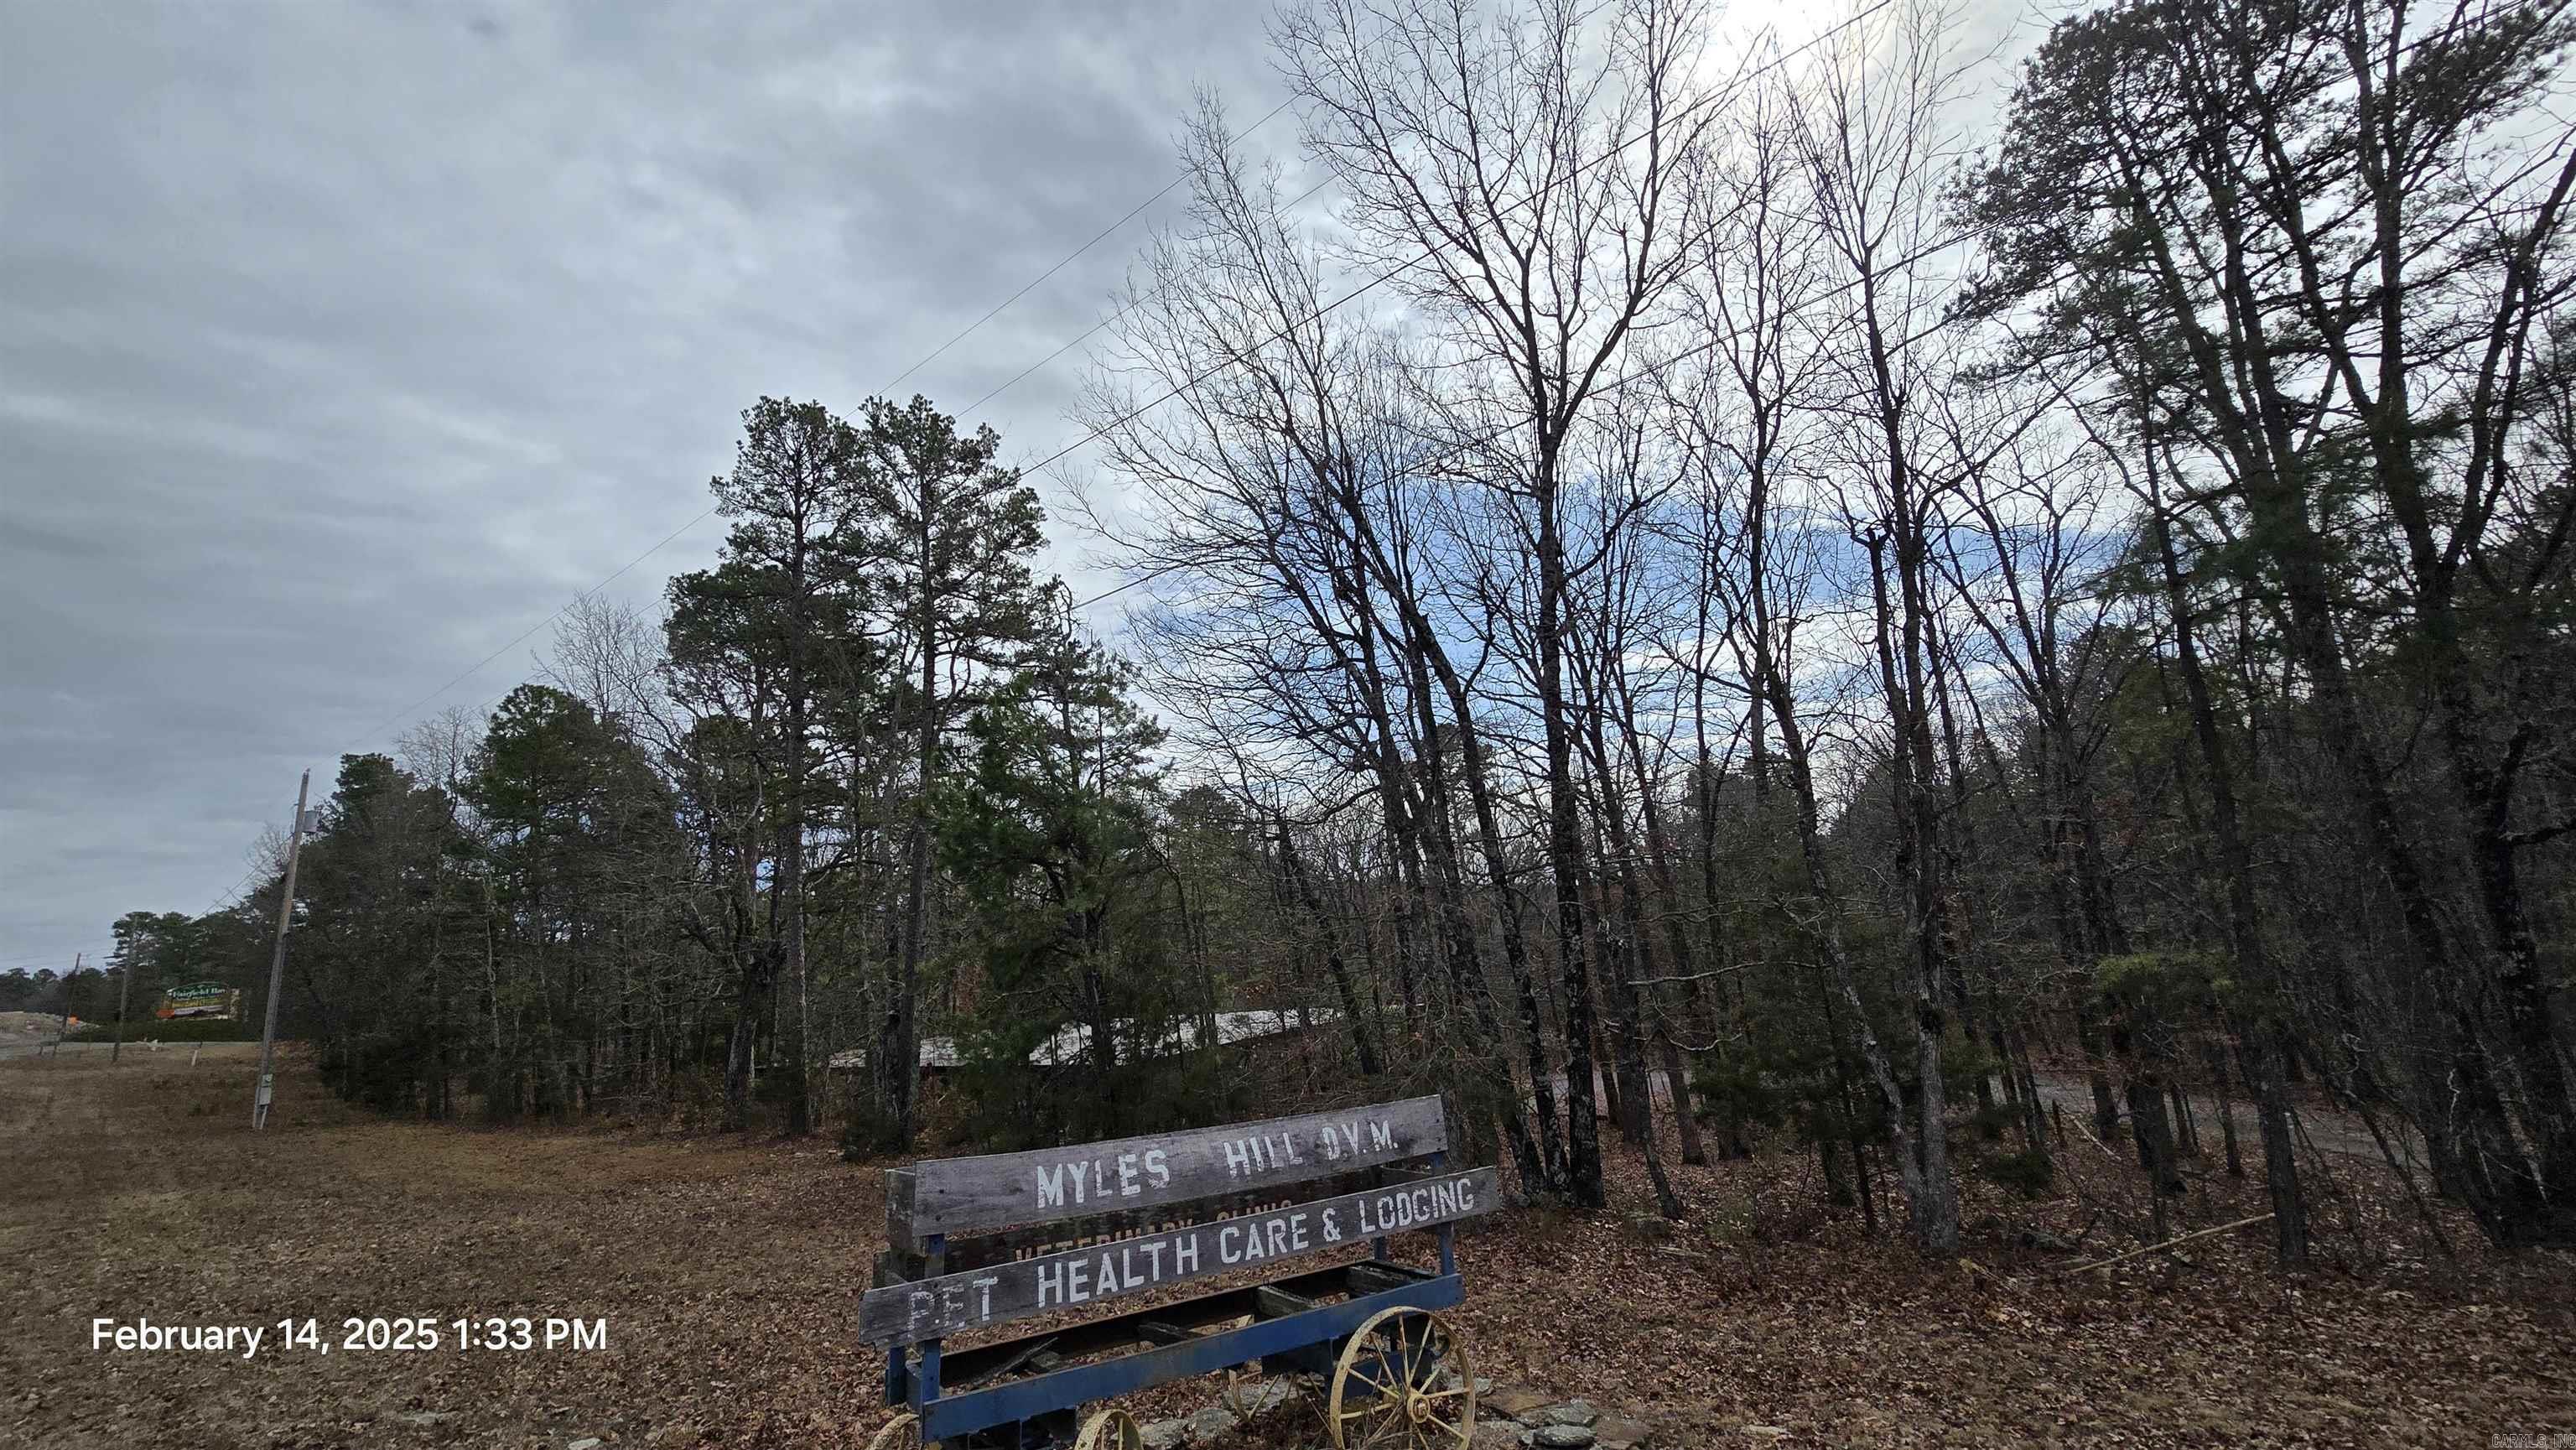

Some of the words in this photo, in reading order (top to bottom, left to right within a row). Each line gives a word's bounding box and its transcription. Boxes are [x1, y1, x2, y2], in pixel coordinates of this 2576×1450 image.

[1036, 1150, 1170, 1208] MYLES
[1224, 1132, 1303, 1178] HILL
[1037, 1233, 1199, 1308] HEALTH
[1219, 1213, 1310, 1264] CARE
[1322, 1208, 1342, 1242] &
[1358, 1177, 1474, 1234] LODGING
